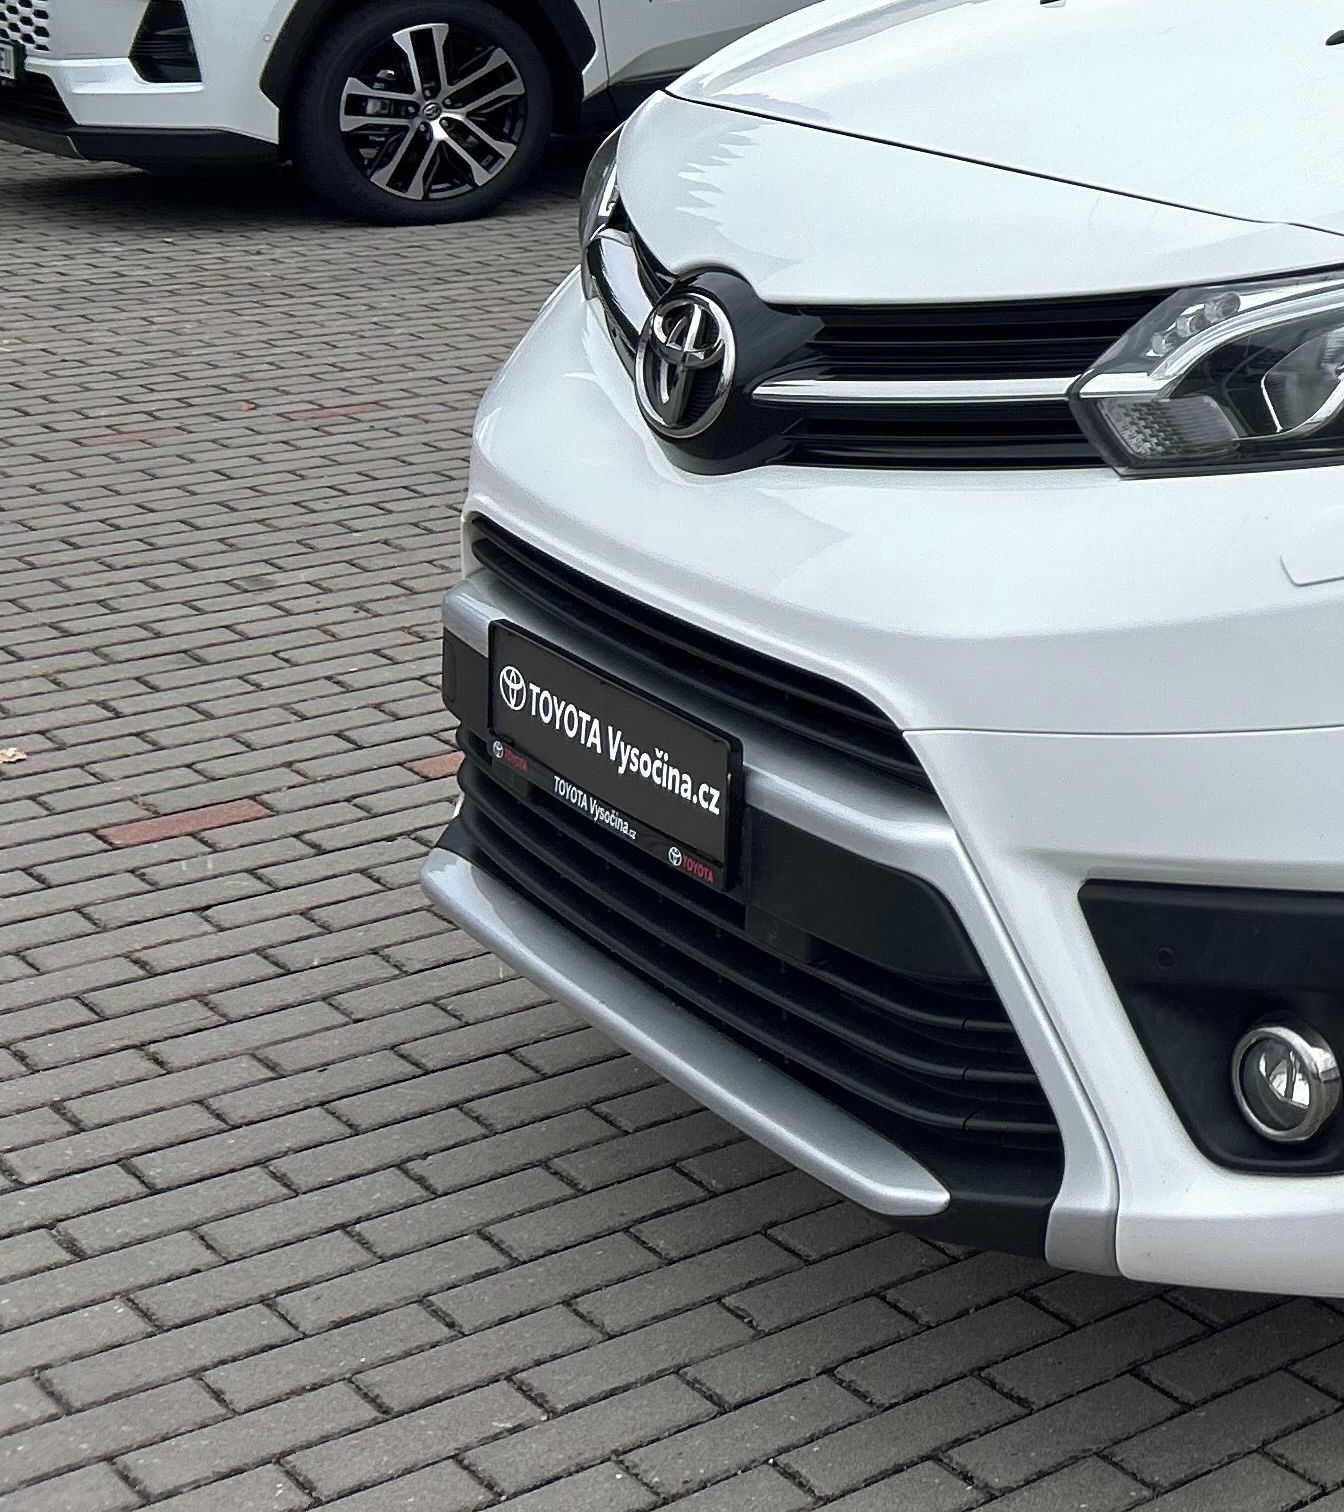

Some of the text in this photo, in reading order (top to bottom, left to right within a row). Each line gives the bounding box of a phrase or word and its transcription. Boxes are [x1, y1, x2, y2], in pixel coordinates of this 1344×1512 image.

[504, 748, 528, 773] TOYOTA
[529, 682, 721, 815] TOYOTA Vysočina.cz
[553, 775, 637, 839] TOYOTA Vysočina.cz
[682, 855, 714, 884] TOYOTA
